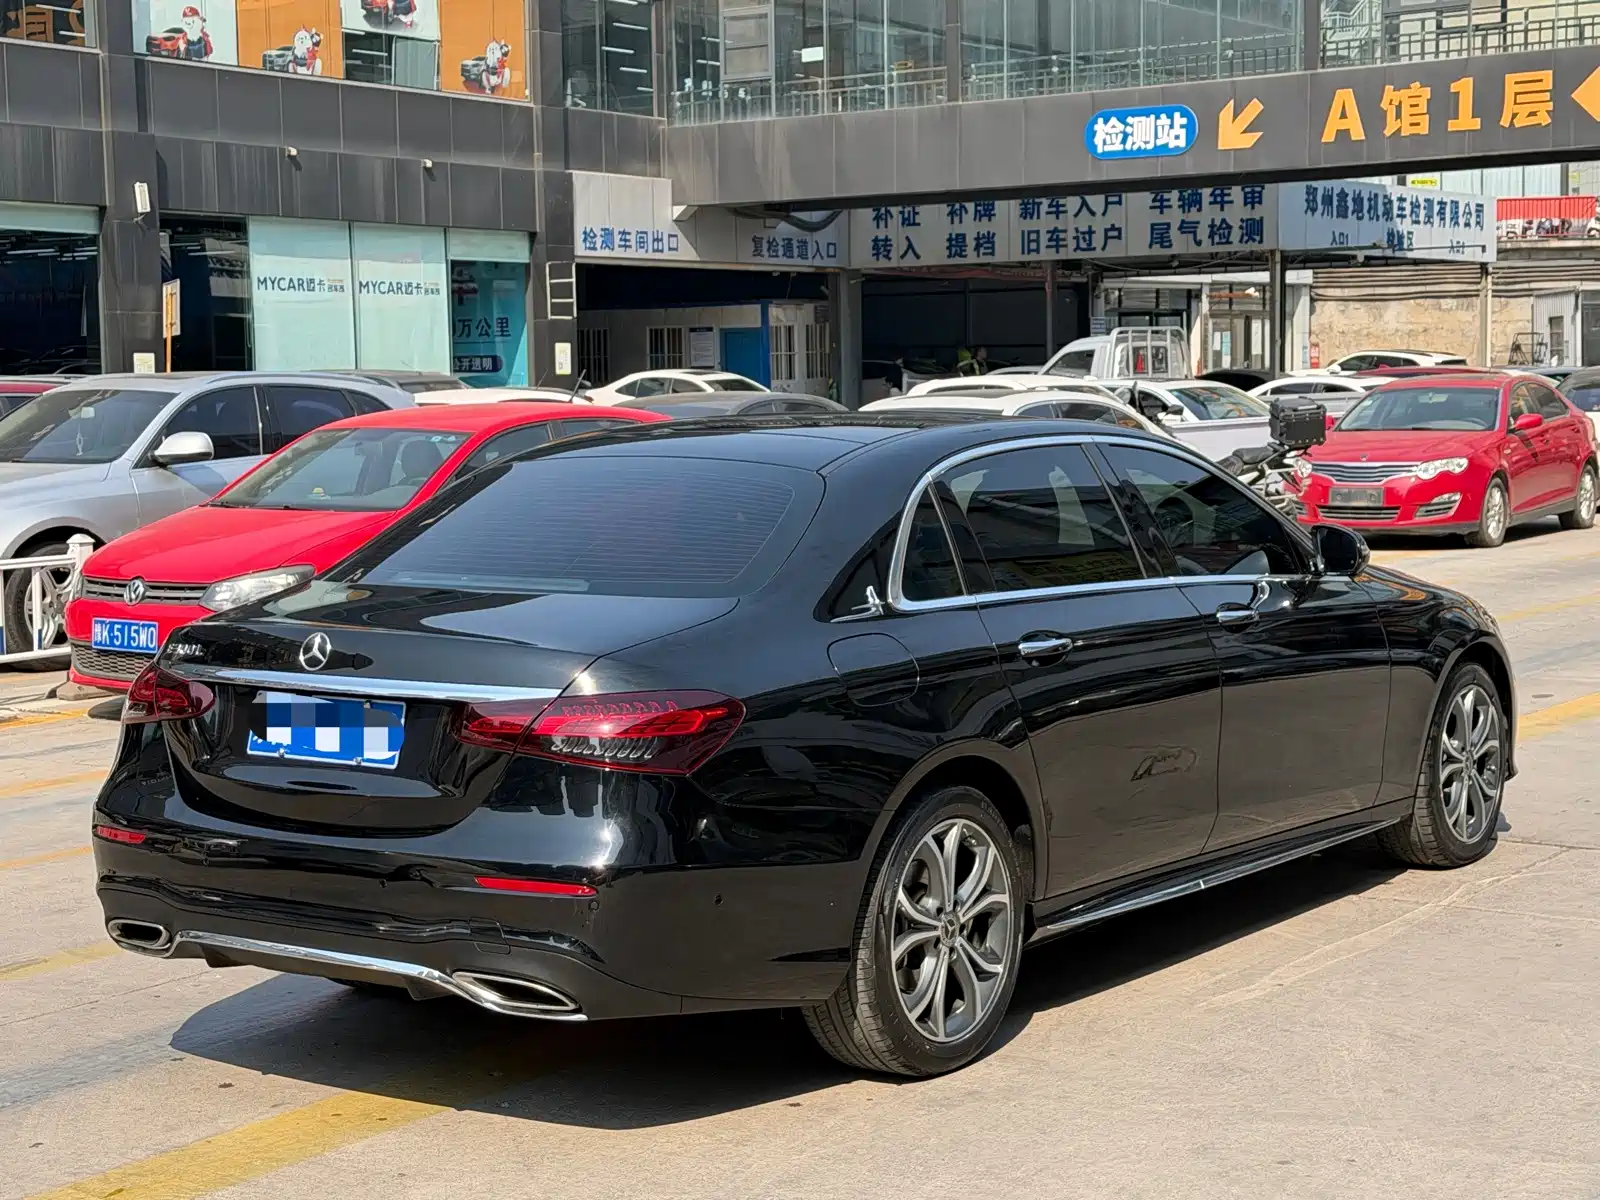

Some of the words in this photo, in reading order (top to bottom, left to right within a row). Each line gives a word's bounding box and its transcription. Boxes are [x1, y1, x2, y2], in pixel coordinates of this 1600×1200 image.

[1321, 69, 1555, 142] A馆1层
[1093, 112, 1187, 152] 检测站
[872, 206, 921, 229] 补证
[946, 201, 996, 224] 补牌
[1019, 193, 1123, 220] 新车入户
[1149, 185, 1265, 215] 车辆年审
[582, 226, 679, 254] 检测车间出口
[752, 235, 838, 260] 复检通道入口
[871, 235, 921, 262] 转入
[946, 230, 996, 259] 提档
[1020, 224, 1123, 255] 旧车过户
[1148, 216, 1264, 250] 尾气检测
